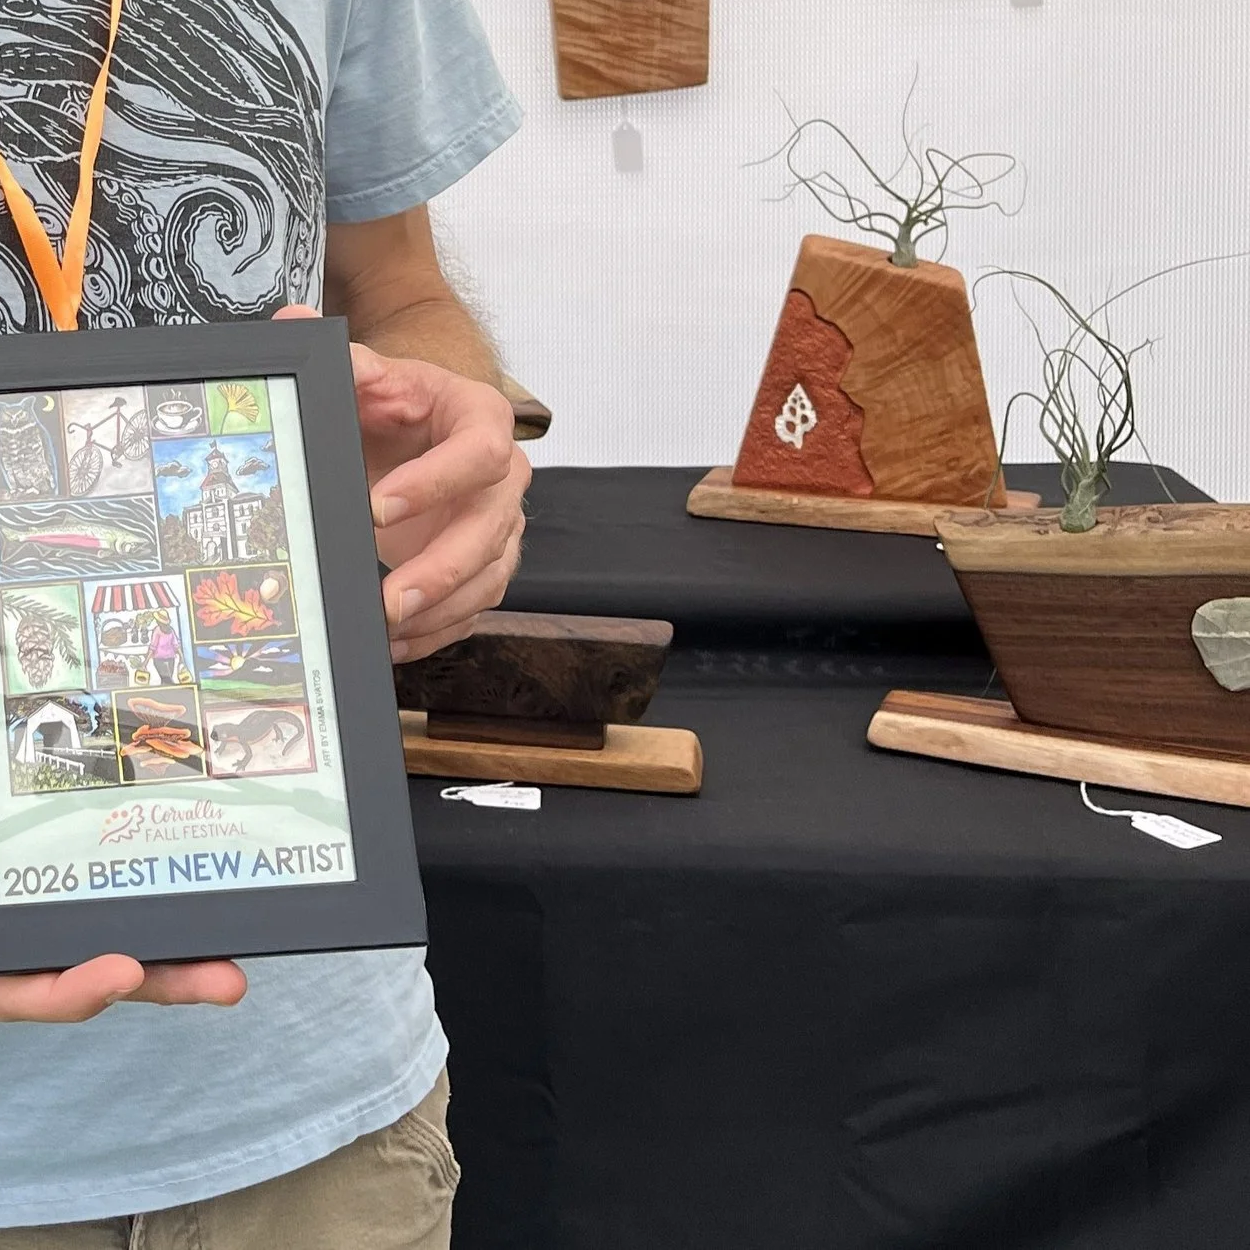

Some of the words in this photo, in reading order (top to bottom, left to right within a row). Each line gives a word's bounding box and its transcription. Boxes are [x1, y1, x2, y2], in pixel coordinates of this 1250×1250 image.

[312, 669, 323, 705] SVATOS
[317, 706, 327, 733] EMMA
[321, 735, 329, 748] BY
[322, 750, 332, 768] ART
[150, 799, 223, 825] Corvallis
[145, 826, 180, 843] FALL
[182, 822, 248, 840] FESTIVAL
[3, 862, 80, 897] 2026
[88, 856, 159, 891] BEST
[168, 850, 241, 884] NEW
[250, 842, 347, 878] ARTIST
